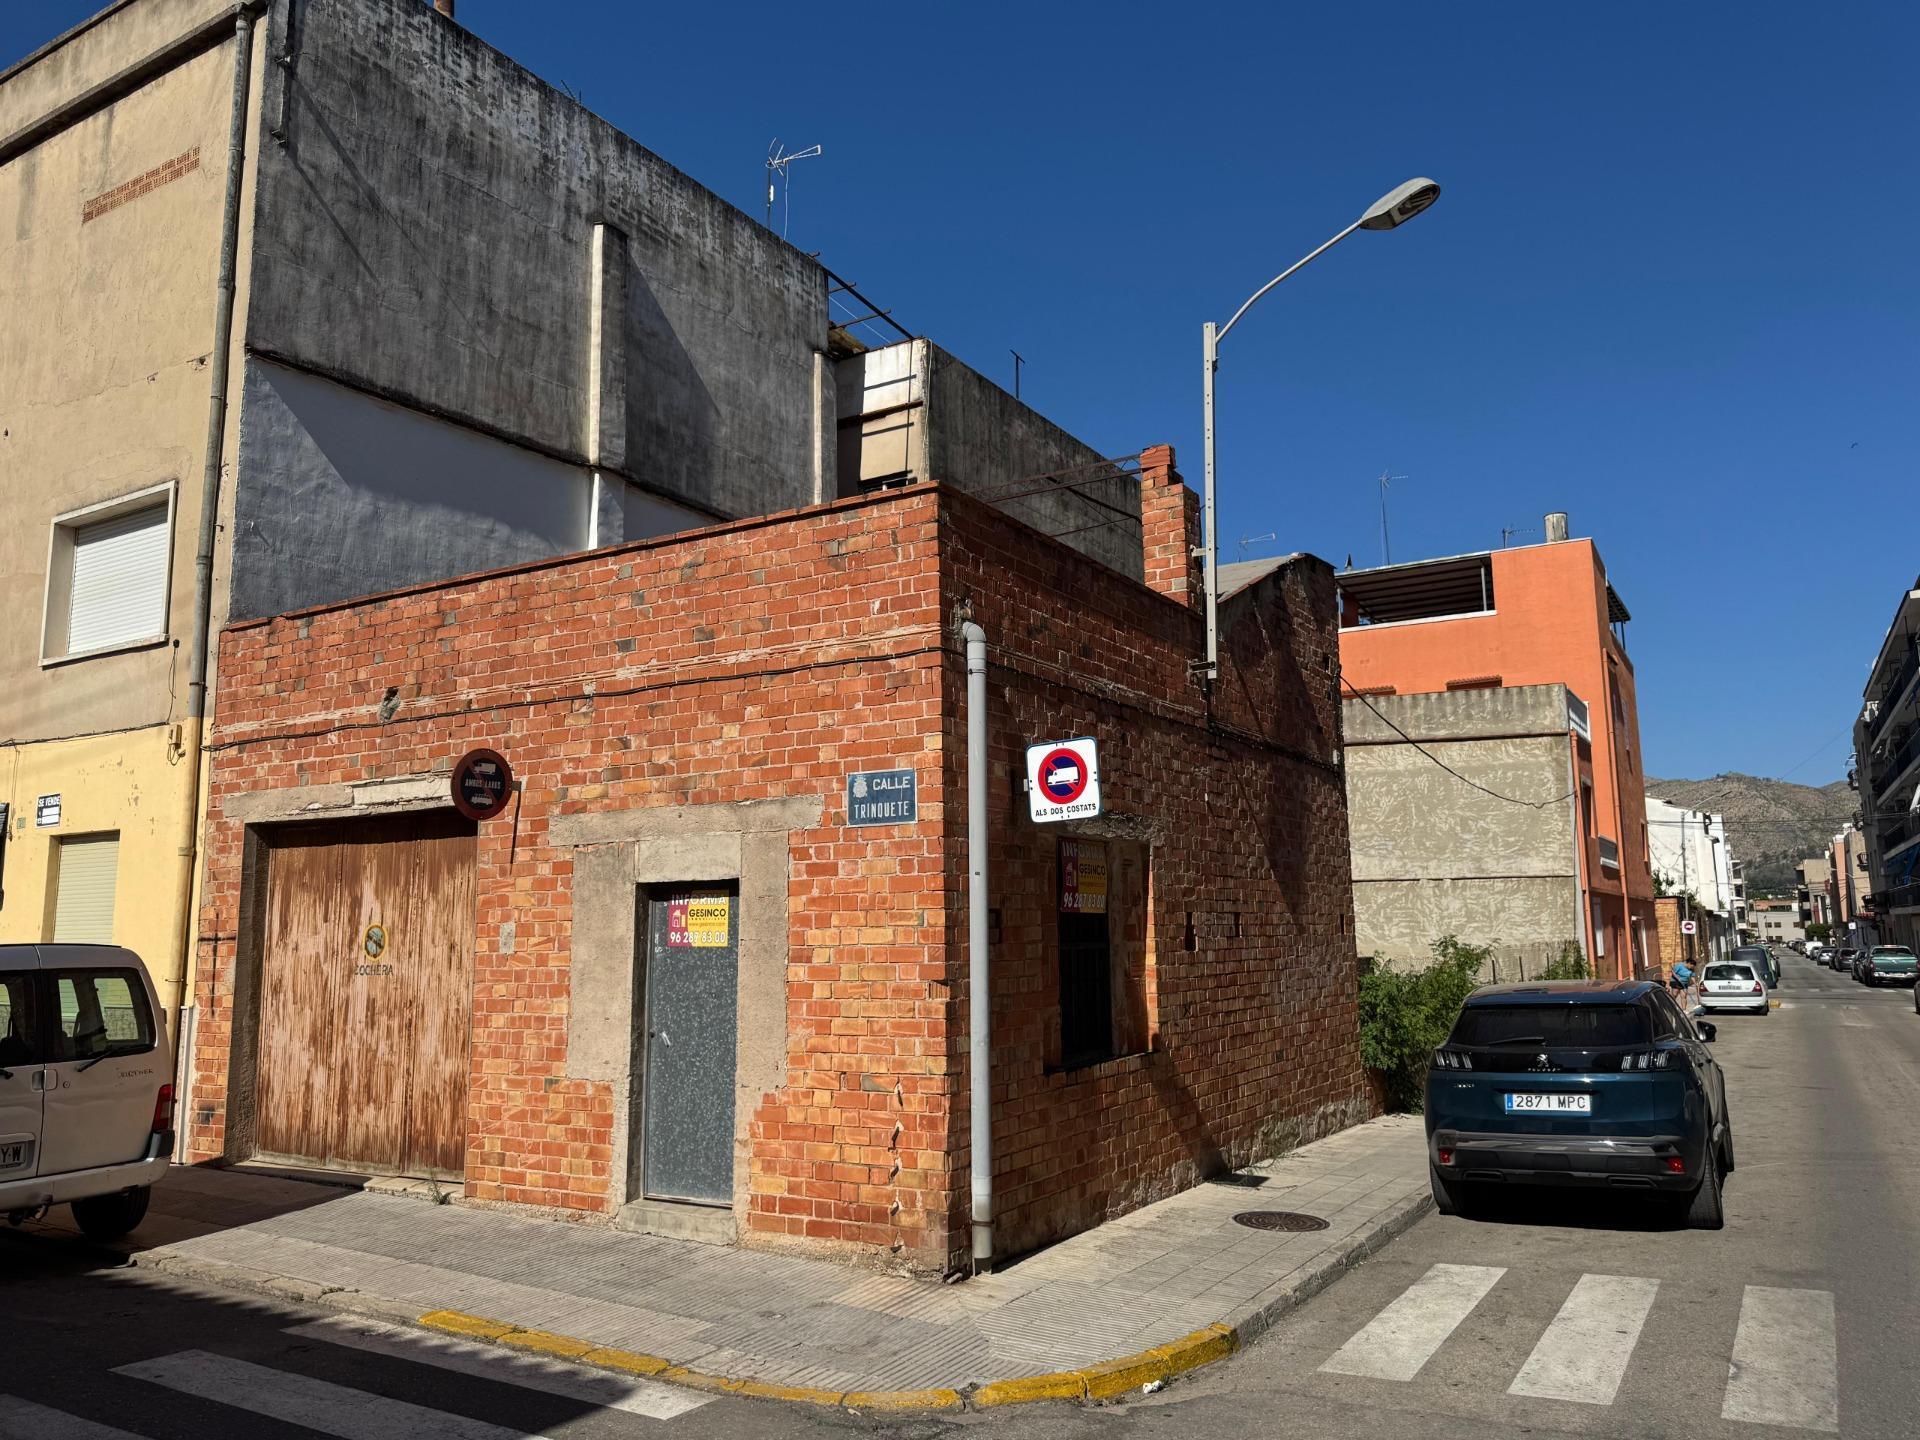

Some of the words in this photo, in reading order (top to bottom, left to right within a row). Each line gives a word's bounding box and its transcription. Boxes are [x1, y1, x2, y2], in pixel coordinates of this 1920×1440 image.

[872, 776, 911, 791] CALLE
[854, 801, 910, 819] TRINQUETE
[1035, 809, 1048, 817] ALS
[1050, 806, 1064, 815] DOS
[1066, 803, 1097, 813] COSTATS
[1079, 863, 1106, 876] GESINCO
[671, 893, 726, 906] INFORMA
[1063, 892, 1073, 908] 96
[688, 908, 727, 918] GESINCO
[670, 931, 681, 943] 96
[683, 931, 699, 943] 287
[701, 931, 713, 943] 83
[714, 931, 726, 943] 00
[1516, 1095, 1552, 1108] 2871
[1558, 1096, 1586, 1109] MPC
